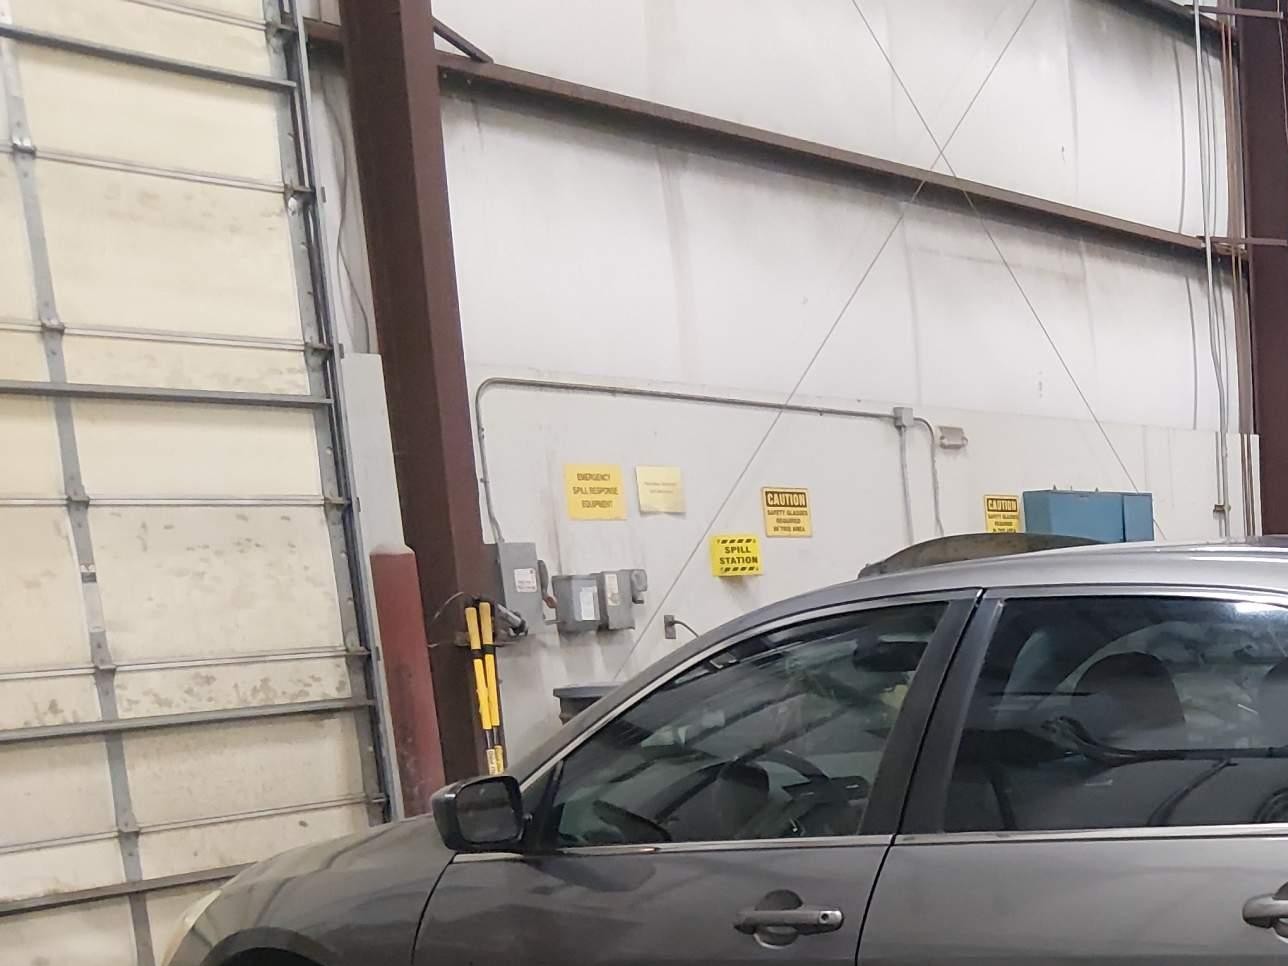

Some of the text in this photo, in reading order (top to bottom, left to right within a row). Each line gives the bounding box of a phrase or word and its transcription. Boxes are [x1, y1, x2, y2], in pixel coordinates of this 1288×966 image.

[767, 493, 806, 506] CAUTION
[988, 500, 1016, 511] CAUTION
[724, 546, 751, 554] SPILL
[719, 556, 758, 565] STATION
